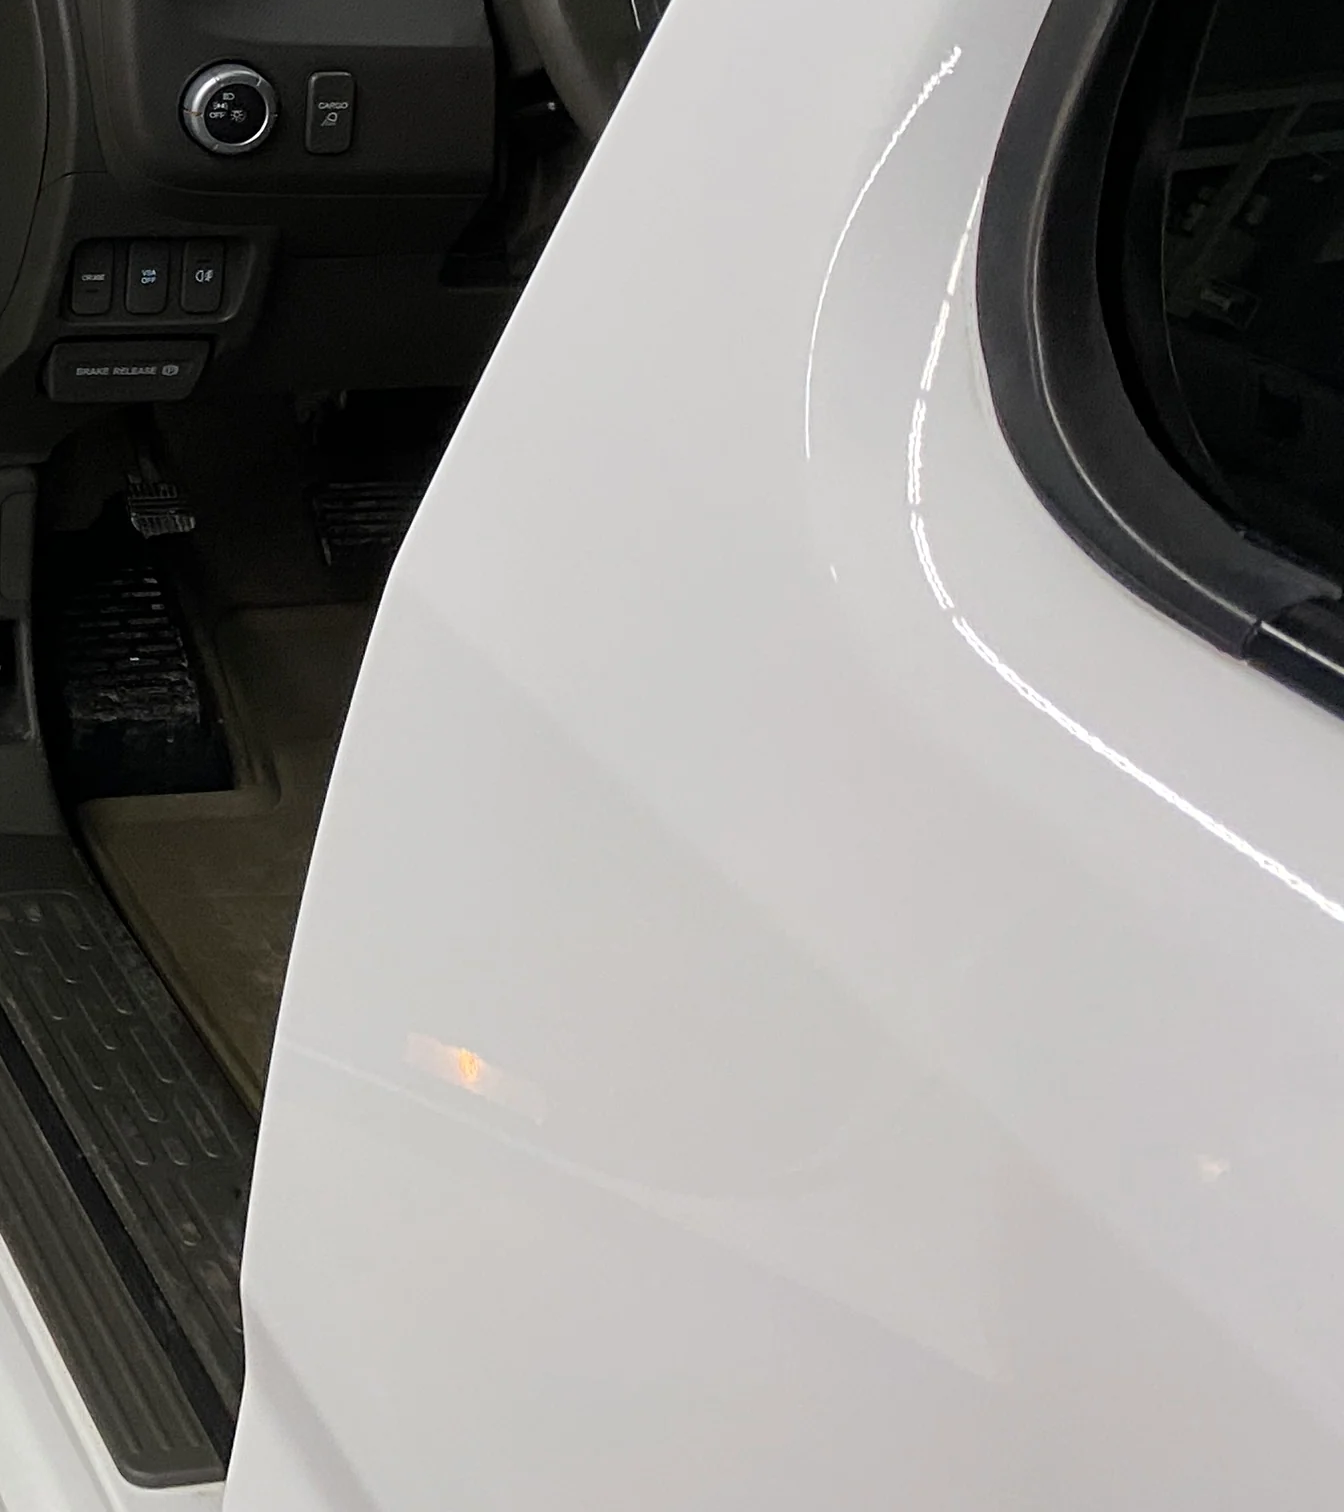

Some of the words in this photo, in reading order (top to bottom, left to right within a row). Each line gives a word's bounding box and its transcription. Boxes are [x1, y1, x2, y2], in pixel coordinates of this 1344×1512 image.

[209, 111, 227, 119] OFF
[76, 366, 110, 376] BRAKE
[113, 366, 158, 375] RELEASE
